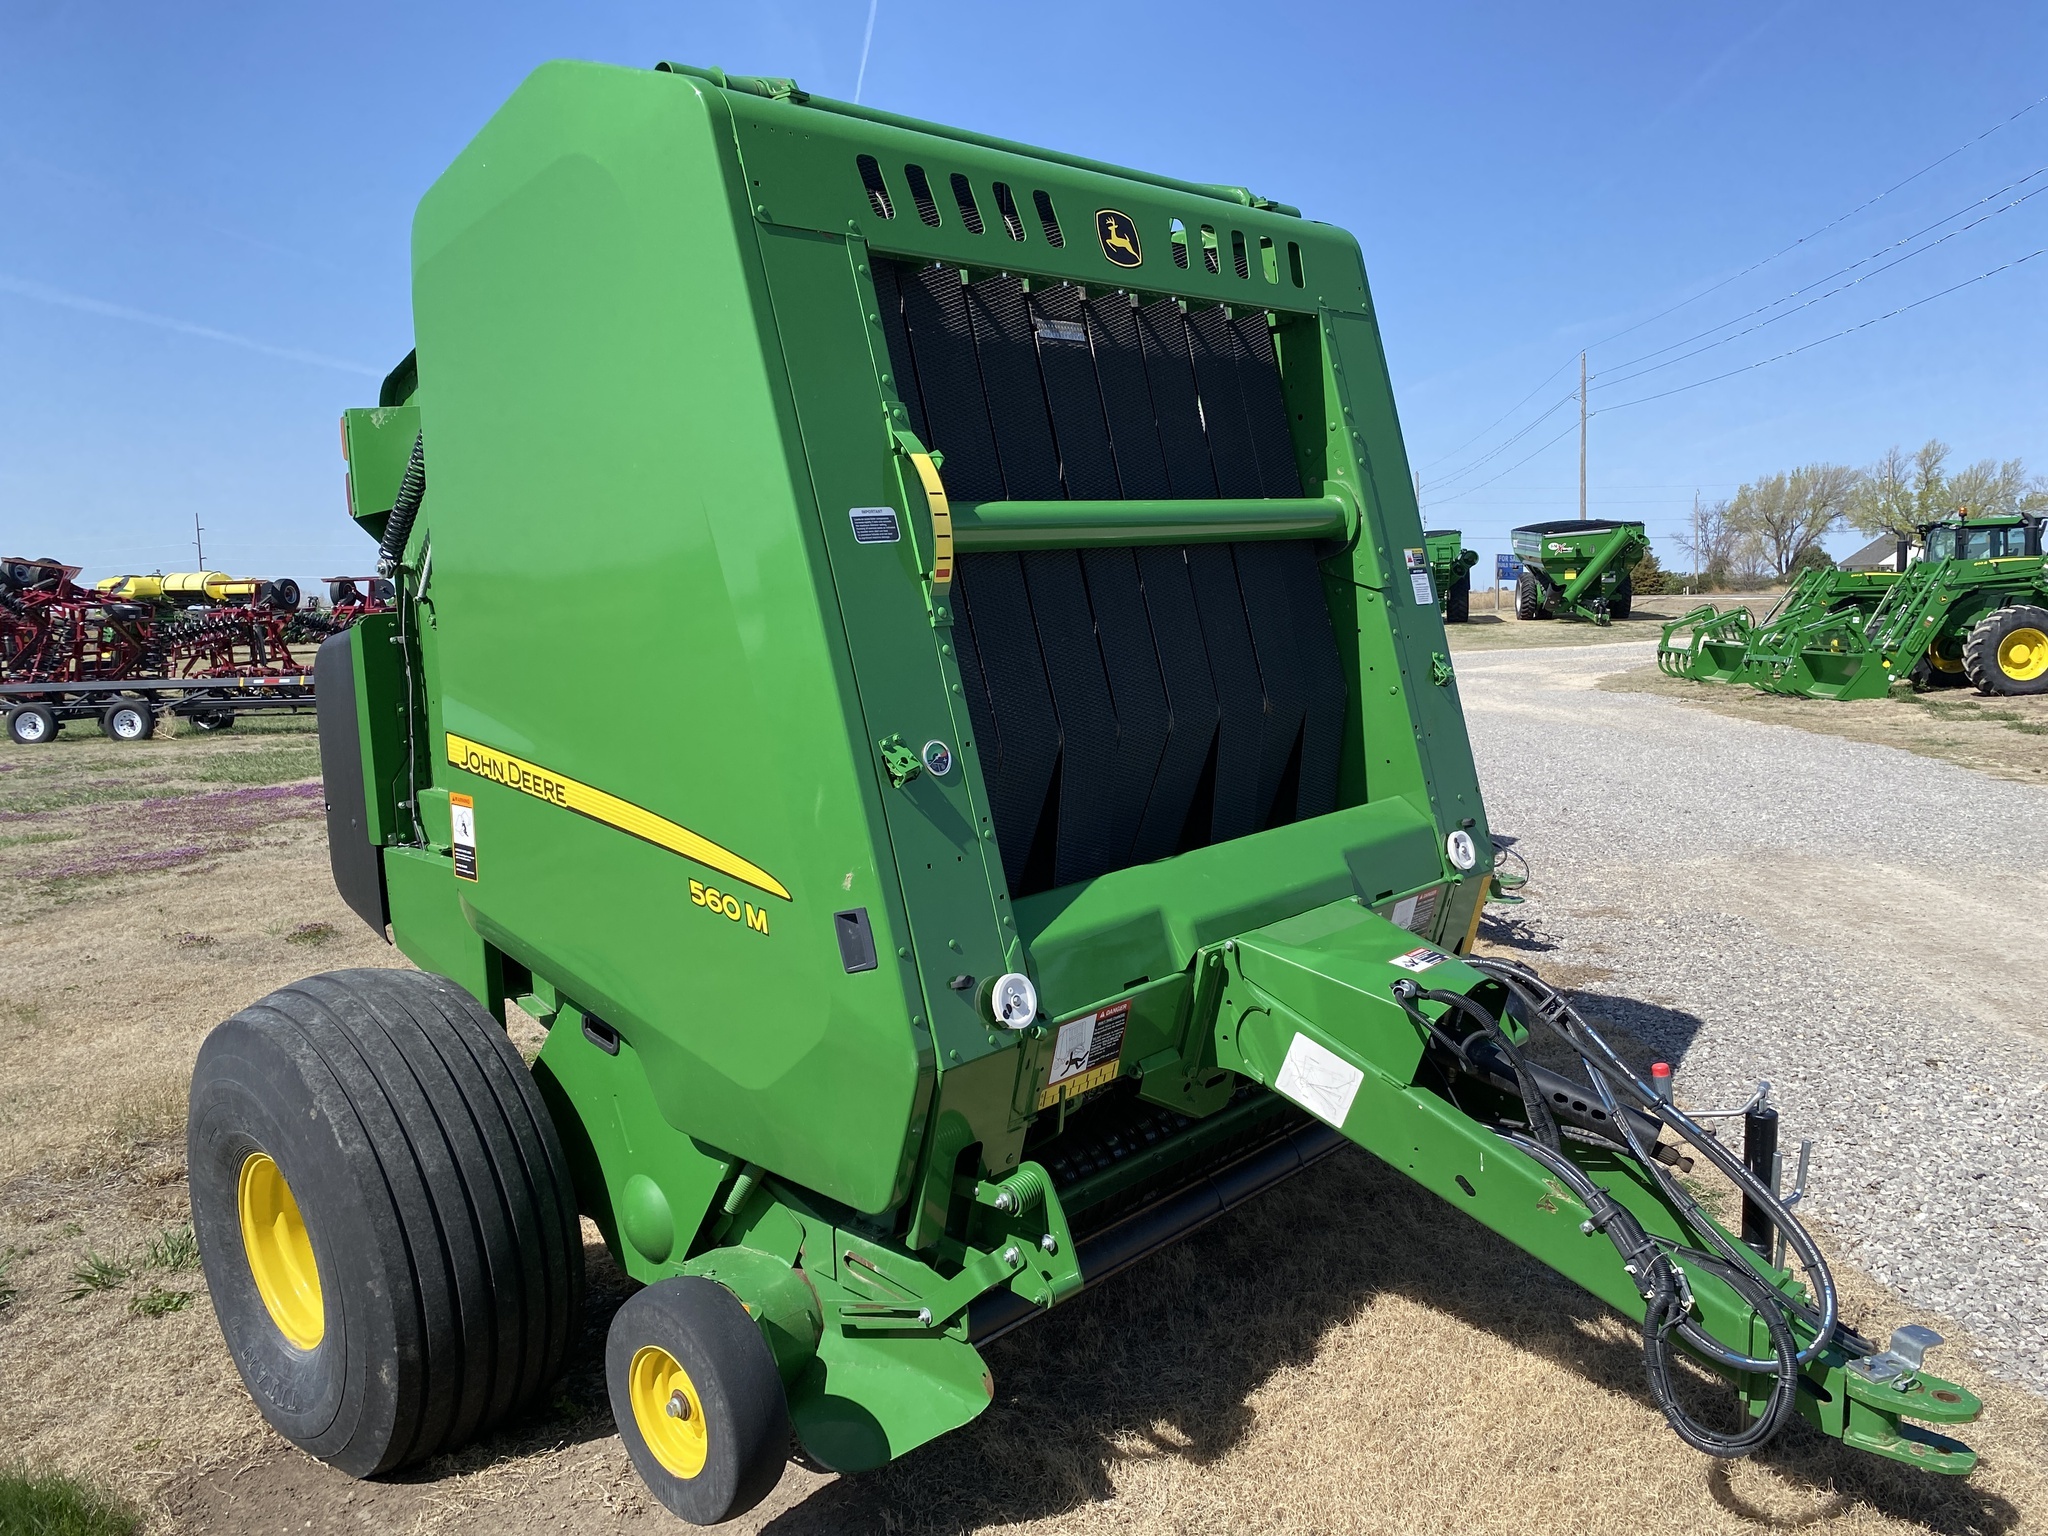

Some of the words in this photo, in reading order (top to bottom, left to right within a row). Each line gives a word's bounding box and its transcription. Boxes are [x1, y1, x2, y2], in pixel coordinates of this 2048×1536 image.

[460, 745, 505, 781] JOHN
[507, 760, 567, 805] DEERE
[688, 877, 742, 922] 560
[744, 901, 769, 936] M
[1105, 1004, 1127, 1016] DANGER
[241, 1346, 298, 1412] TITAN
